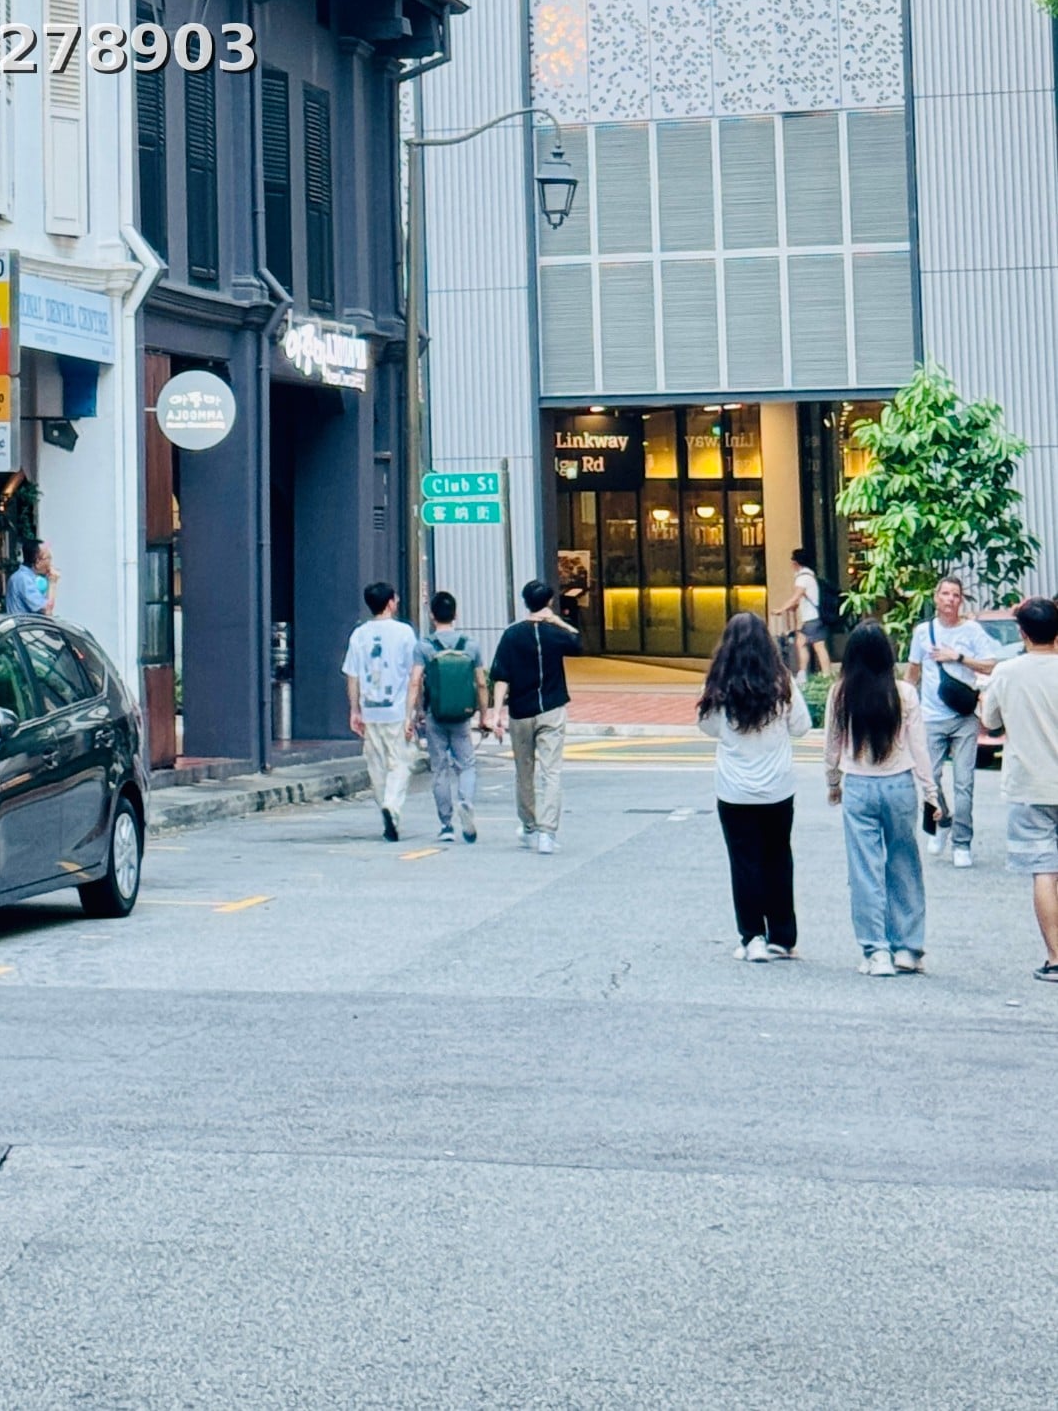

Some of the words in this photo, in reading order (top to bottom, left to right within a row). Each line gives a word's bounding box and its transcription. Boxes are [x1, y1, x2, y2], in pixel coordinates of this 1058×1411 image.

[555, 431, 629, 451] Linkway
[582, 456, 605, 472] Rd
[432, 478, 470, 494] Club
[477, 476, 494, 491] St
